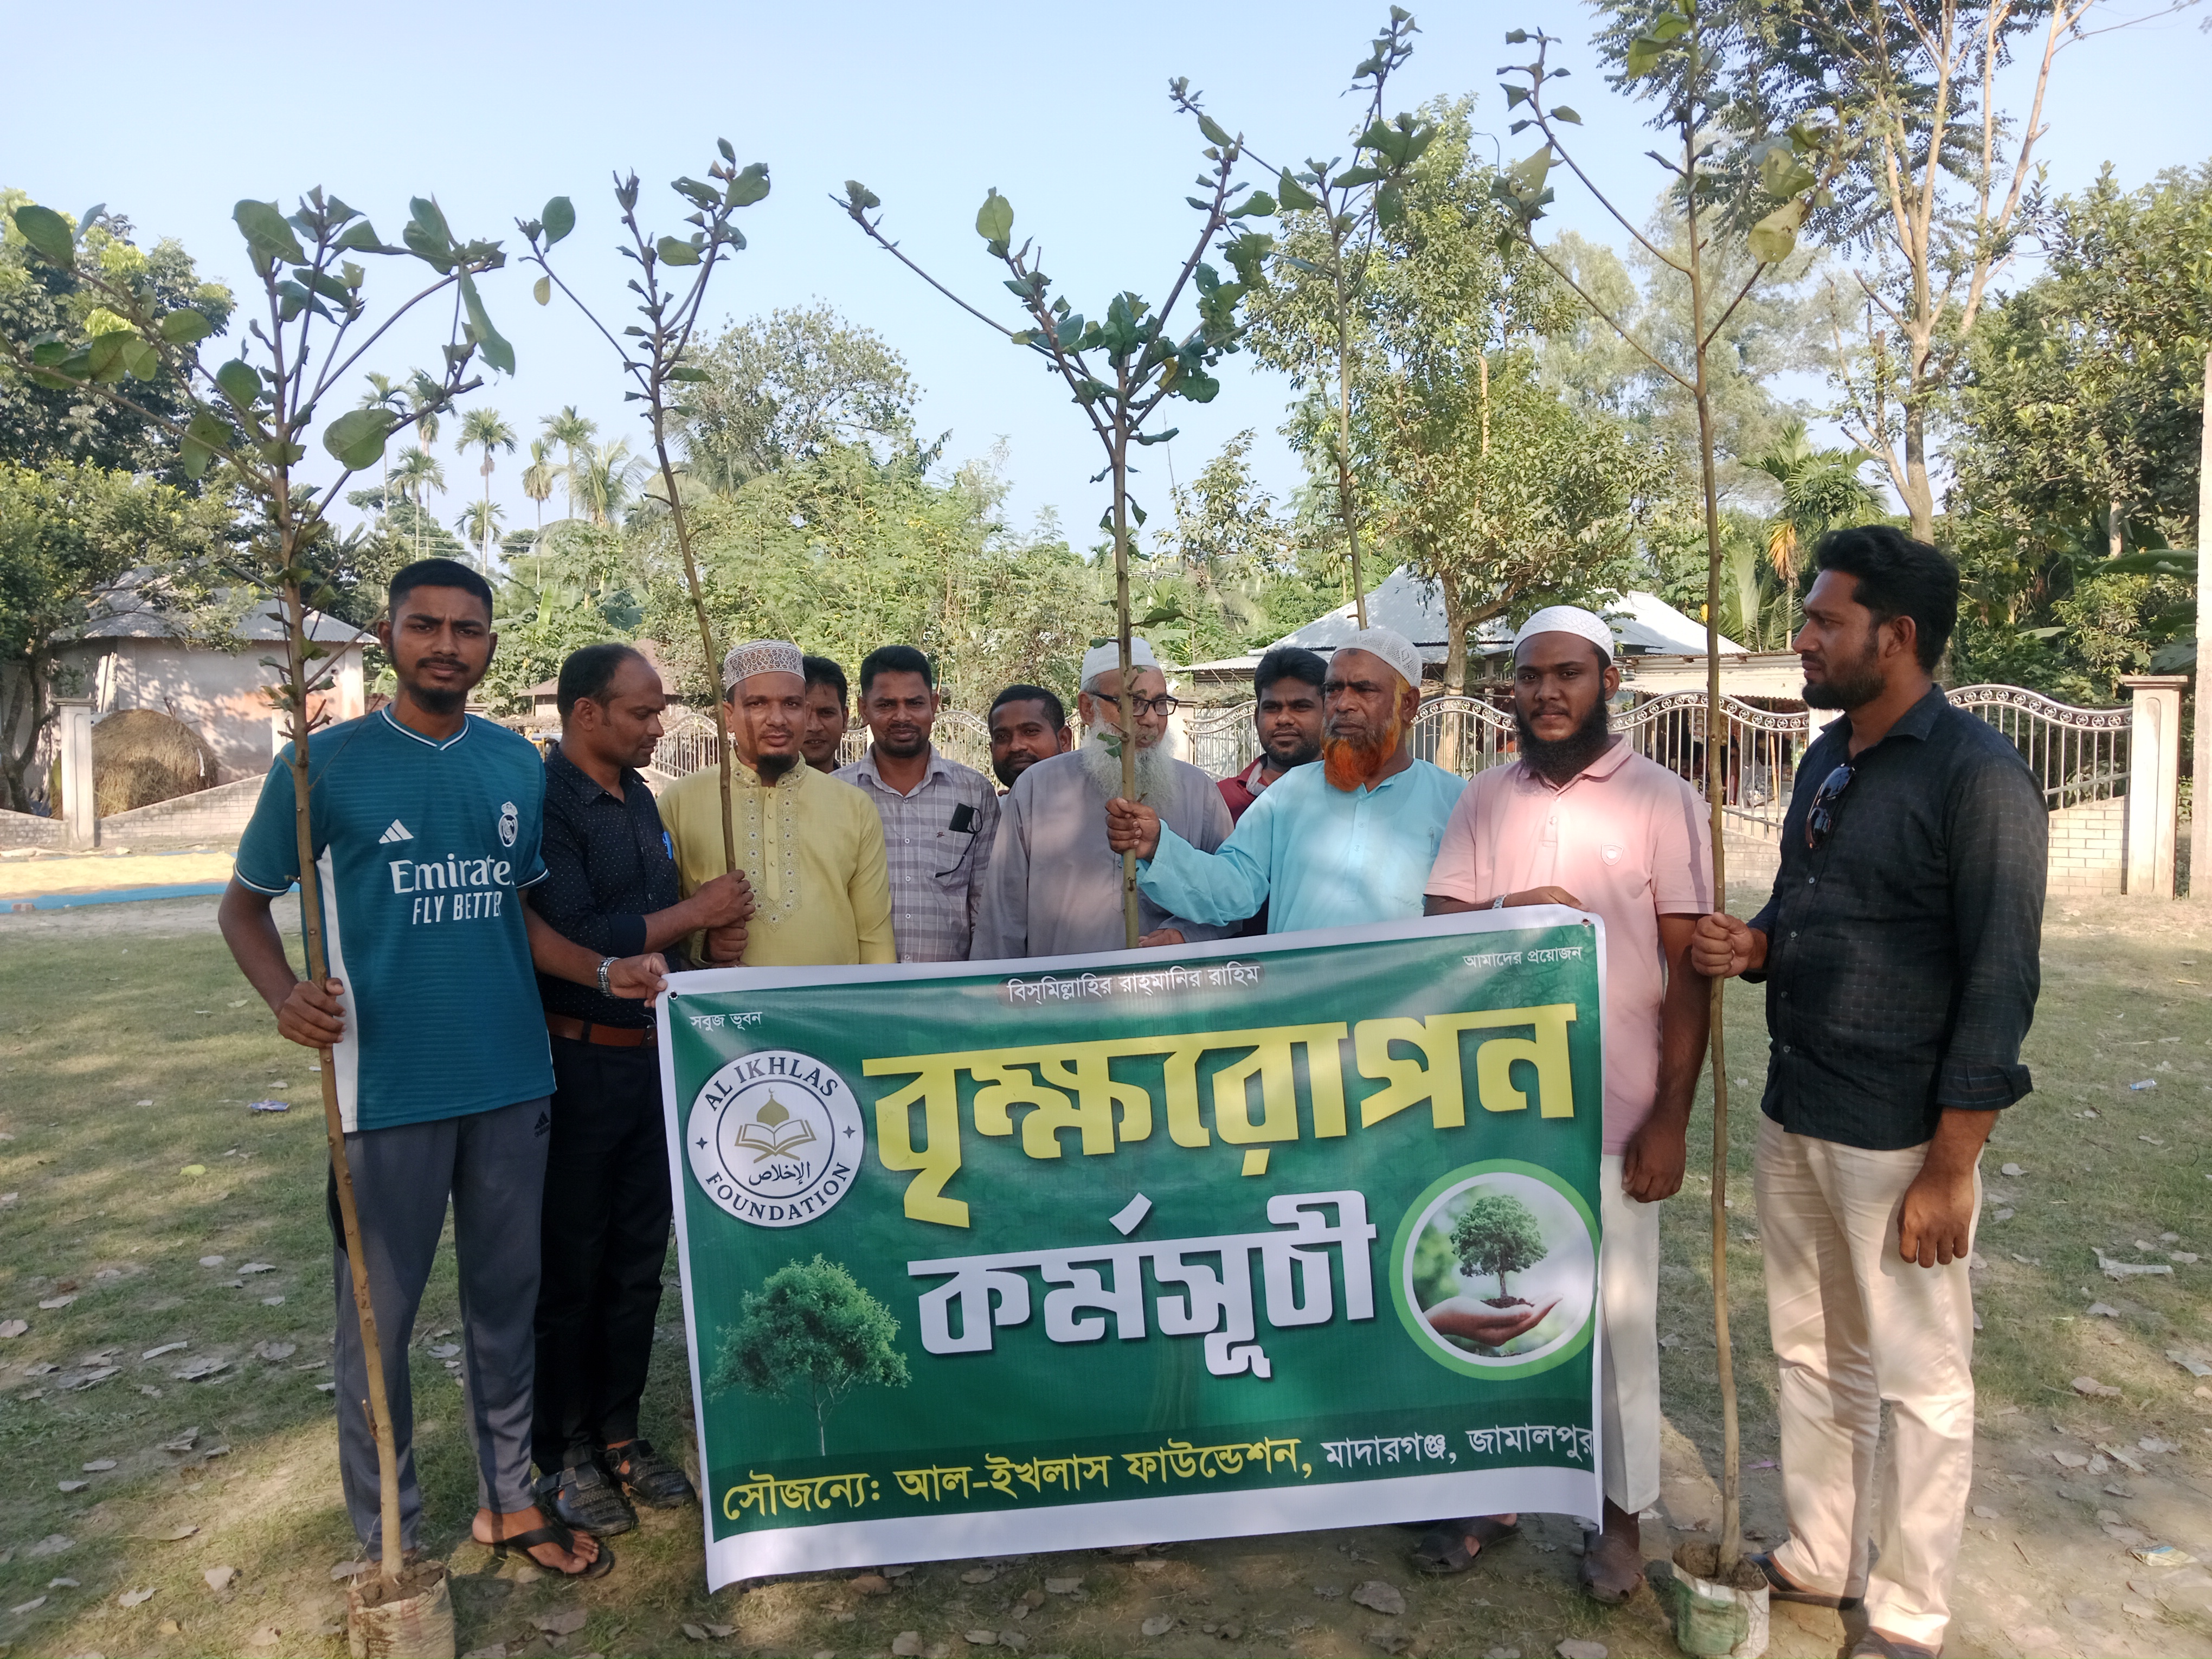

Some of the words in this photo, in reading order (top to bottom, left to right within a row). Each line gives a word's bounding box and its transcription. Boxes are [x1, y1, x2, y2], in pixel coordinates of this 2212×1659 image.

[389, 853, 515, 894] Emirate
[413, 895, 445, 925] FLY
[1208, 961, 1260, 987] রাহিম
[1462, 951, 1523, 968] আমাদের
[1527, 947, 1583, 964] প্রয়োজন
[689, 1014, 726, 1031] সবুজ
[729, 1012, 763, 1031] ভূবন
[705, 1081, 733, 1111] AL
[734, 1057, 839, 1096] IKHLAS
[862, 1003, 1577, 1229] বৃক্ষরোপন
[705, 1162, 851, 1221] FOUNDATION
[749, 1161, 811, 1186] الإخلاص
[907, 1189, 1377, 1379] কর্মসূচী
[723, 1470, 880, 1520] সৌজন্যে:
[892, 1453, 1113, 1502] আল-ইখলাস
[1121, 1437, 1312, 1484] ফাউন্ডেশন,
[1320, 1431, 1457, 1468] মাদারগঞ্জ,
[1465, 1422, 1593, 1463] জামালপুর
